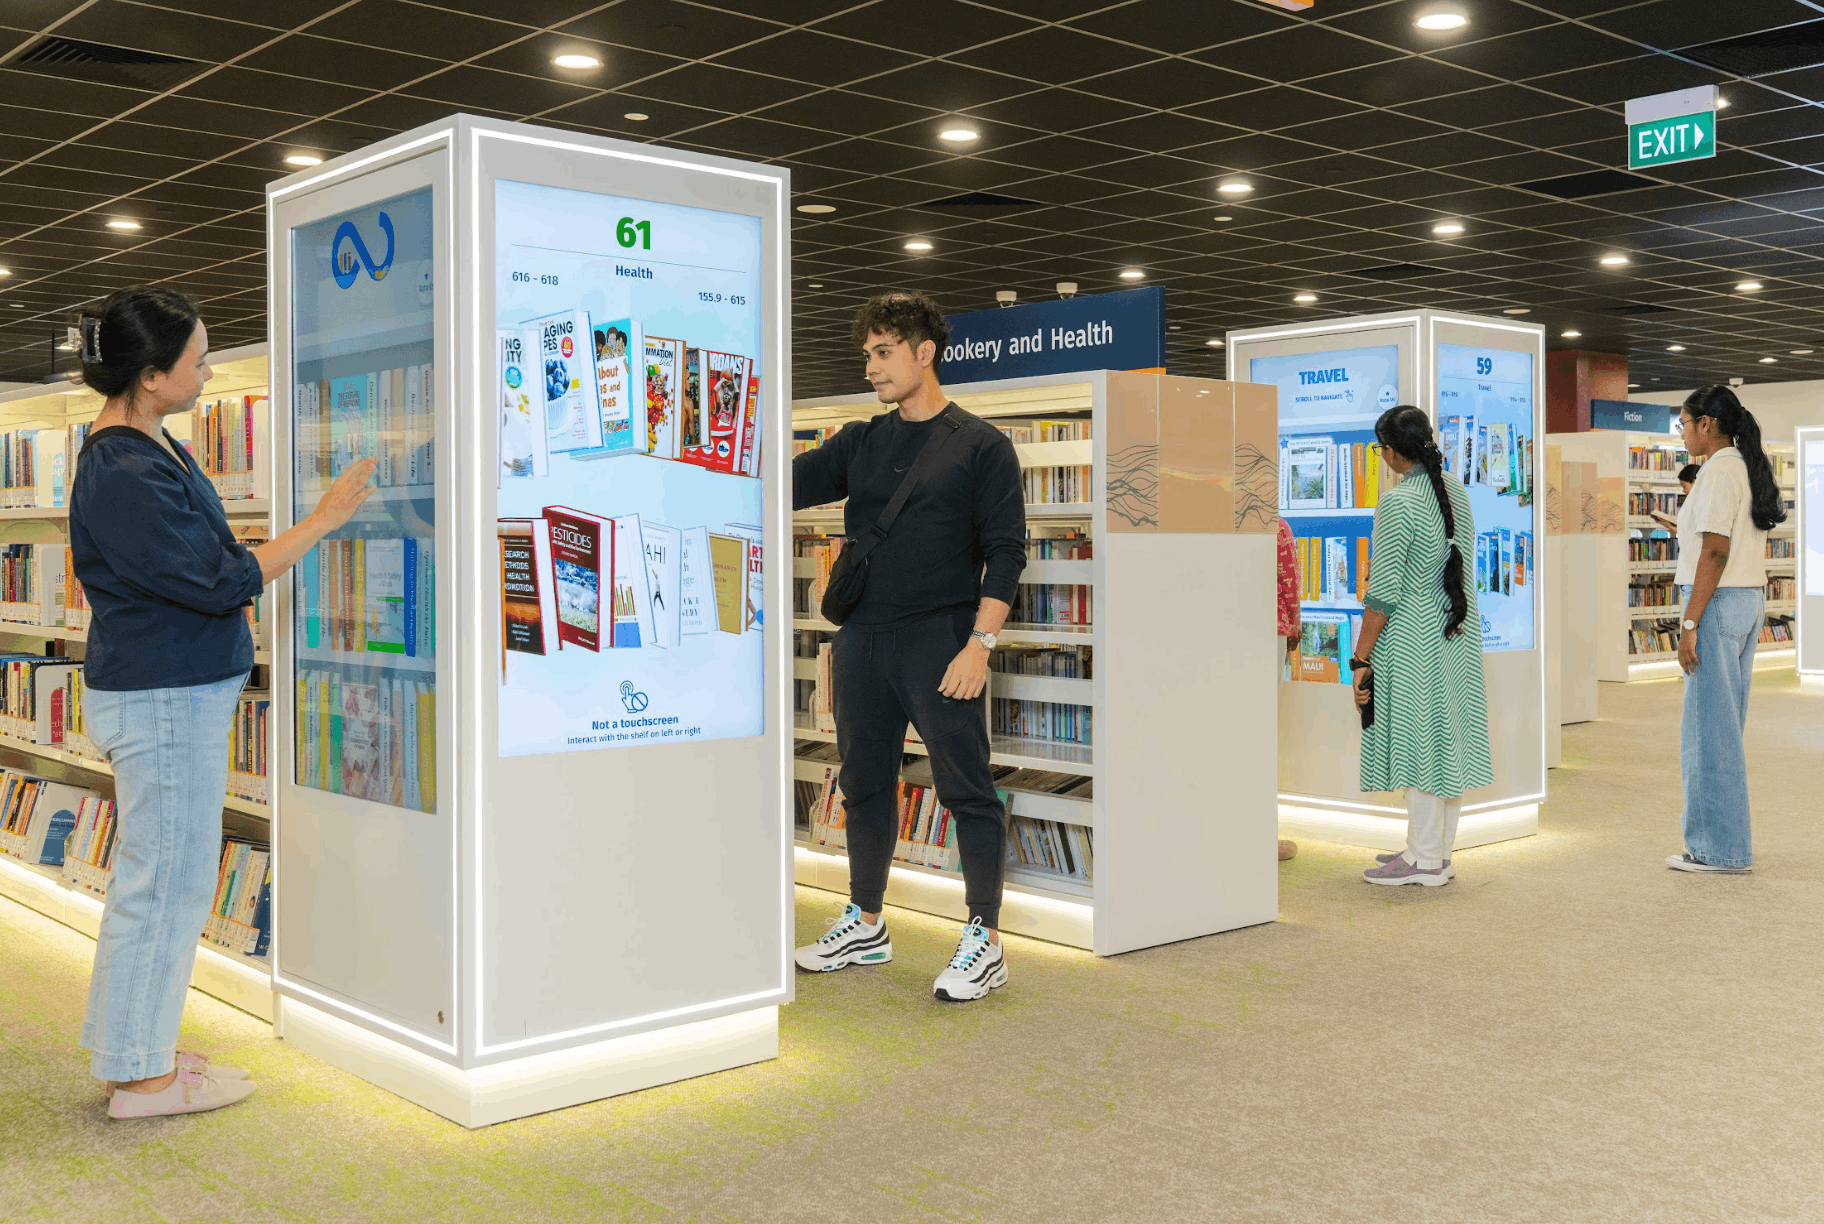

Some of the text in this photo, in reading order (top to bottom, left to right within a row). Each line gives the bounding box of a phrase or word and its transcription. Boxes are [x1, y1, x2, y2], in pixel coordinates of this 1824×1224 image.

[1639, 124, 1690, 160] EXIT
[616, 217, 651, 250] 61
[512, 271, 530, 283] 616
[541, 275, 559, 286] 618
[616, 265, 653, 280] Health
[698, 291, 722, 303] 155.9
[730, 295, 746, 306] 615
[544, 321, 573, 339] AGING
[940, 319, 1113, 363] ookery and Health
[1476, 356, 1492, 375] 59
[1298, 368, 1349, 385] TRAVEL
[609, 380, 621, 392] and
[1624, 411, 1643, 422] Fiction
[551, 526, 592, 548] ESTICIDES
[1303, 662, 1324, 671] MAUI
[592, 716, 679, 730] Not a touchscreen
[567, 735, 597, 744] Interact
[599, 733, 615, 742] with
[616, 731, 629, 741] the
[630, 730, 649, 740] shelf
[661, 729, 673, 737] left
[675, 728, 683, 736] or
[684, 727, 701, 737] right
